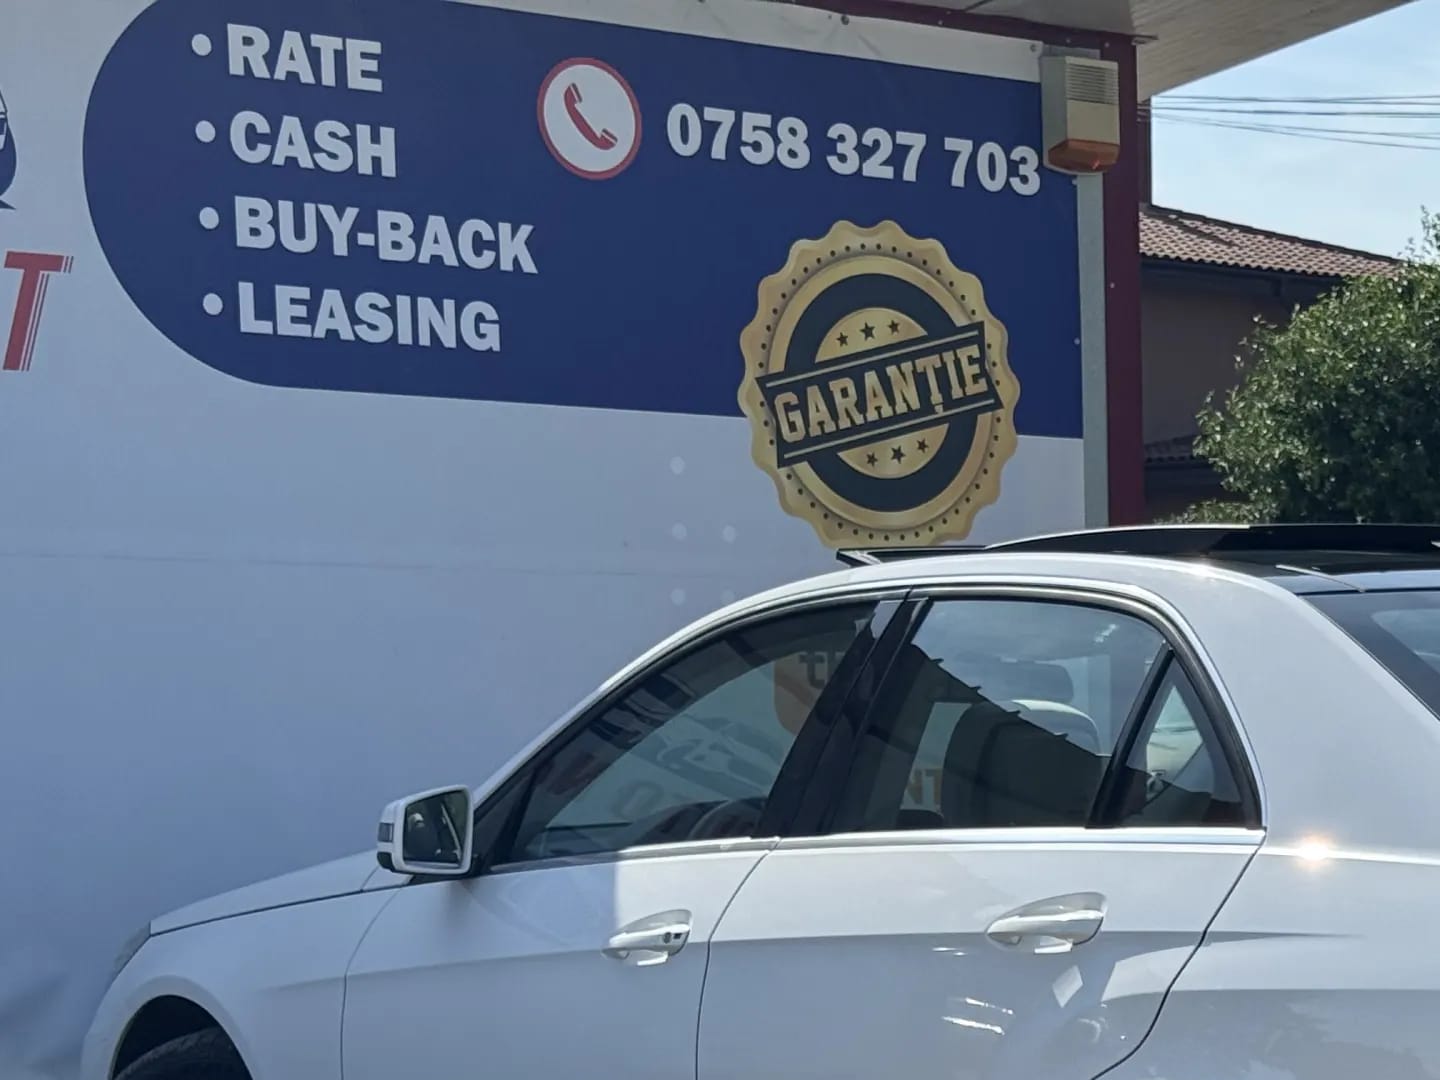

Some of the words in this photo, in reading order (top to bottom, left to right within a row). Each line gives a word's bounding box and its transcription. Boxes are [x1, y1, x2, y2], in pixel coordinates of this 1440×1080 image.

[227, 23, 384, 93] RATE
[229, 110, 398, 178] CASH
[666, 102, 811, 170] 0758
[826, 122, 927, 183] 327
[943, 137, 1042, 196] 703
[234, 195, 539, 275] BUY-BACK
[238, 281, 501, 352] LEASING
